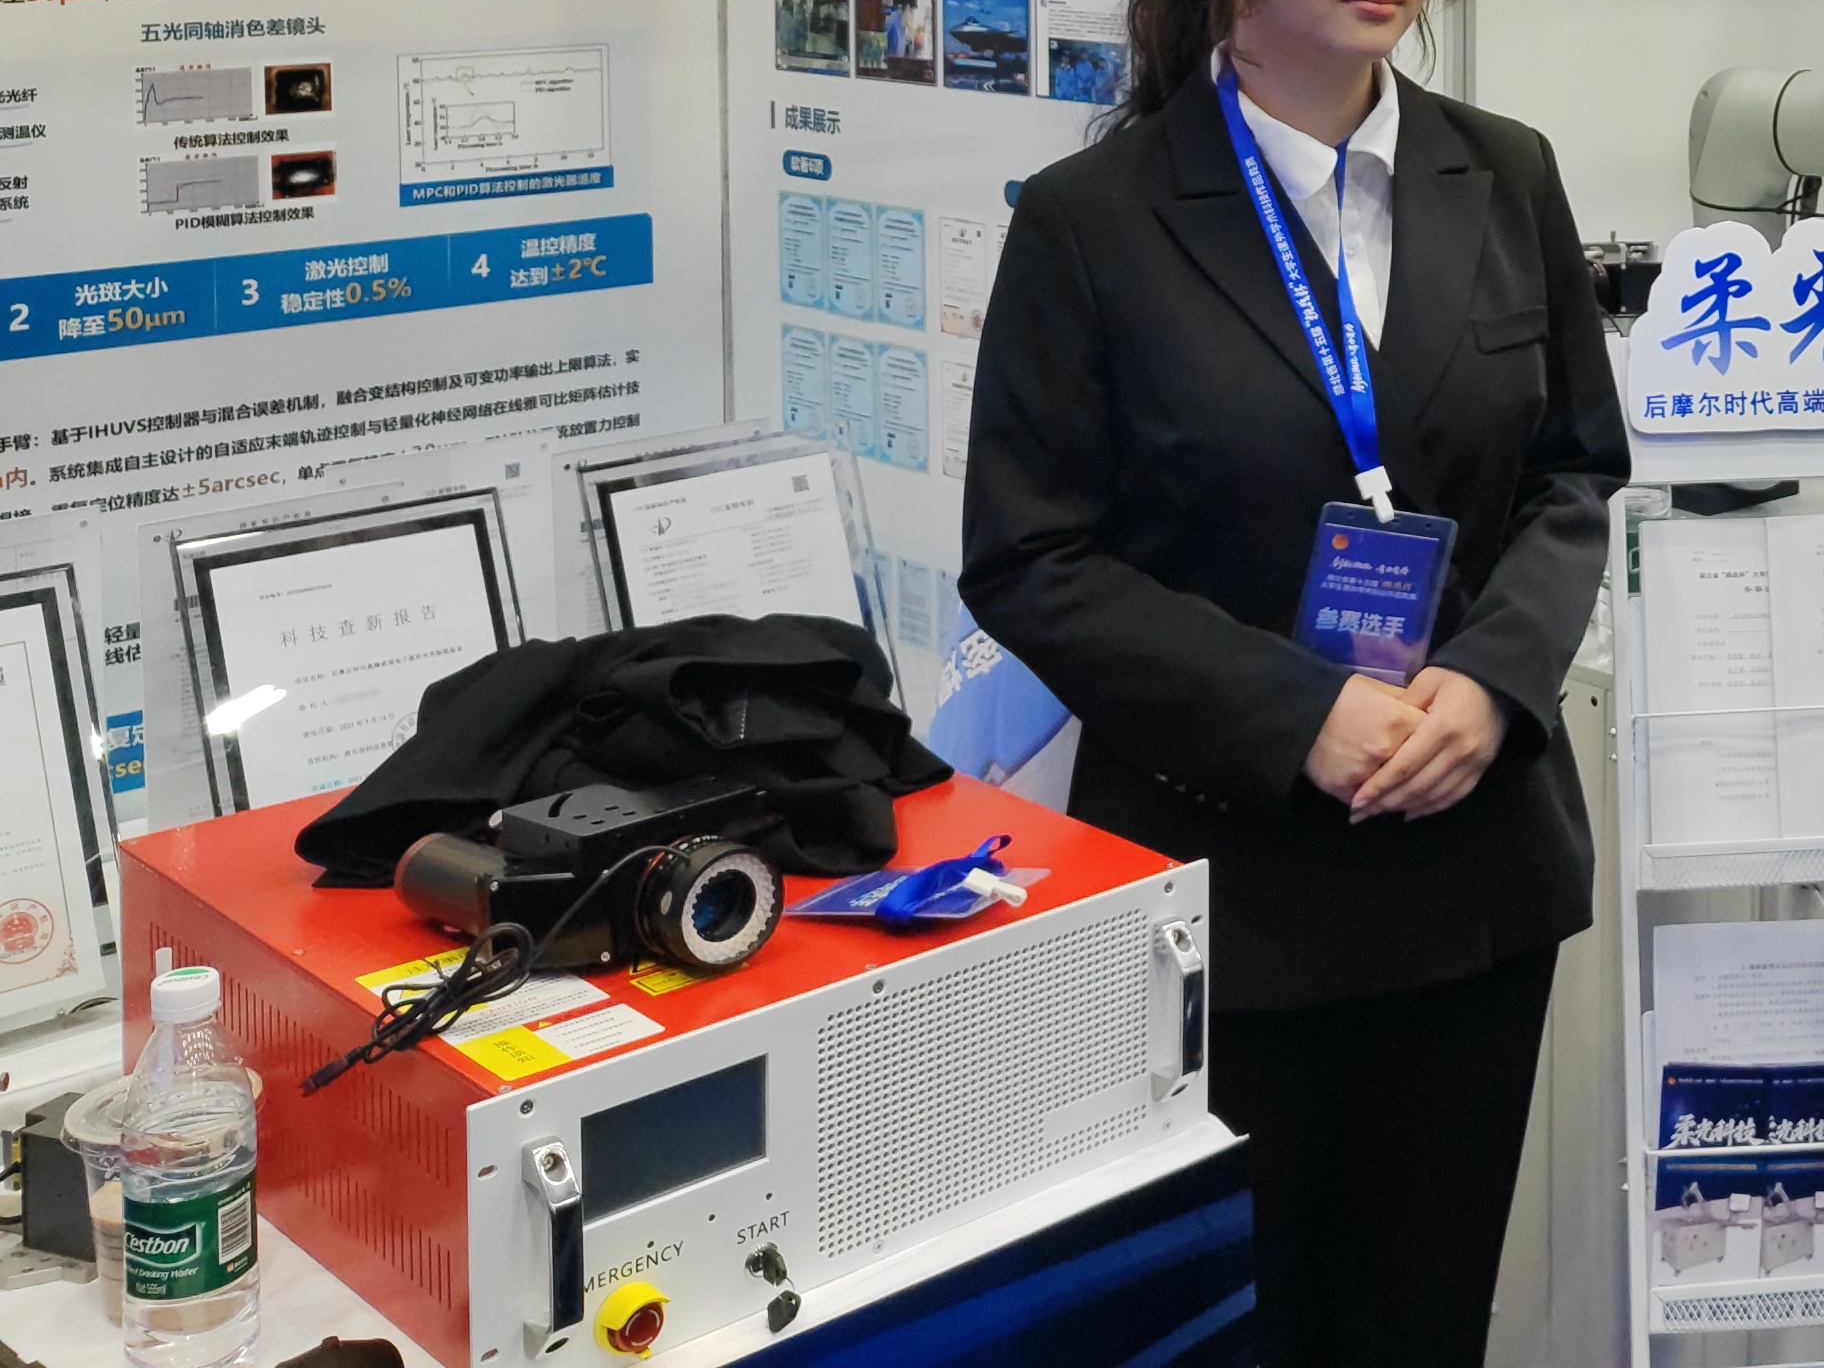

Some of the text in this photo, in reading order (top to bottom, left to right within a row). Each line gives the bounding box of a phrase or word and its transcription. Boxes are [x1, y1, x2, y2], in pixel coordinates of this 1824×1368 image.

[140, 16, 326, 43] 五光同轴消色差镜头
[0, 88, 38, 103] 光纤
[785, 104, 841, 134] 成果展示
[173, 128, 290, 151] 传统算法控制效果
[520, 232, 597, 260] 温控精度
[304, 252, 390, 282] 激光控制
[470, 253, 491, 279] 4
[75, 276, 169, 308] 光斑大小
[241, 278, 260, 306] 3
[280, 276, 412, 316] 稳定性0.5%
[9, 303, 30, 333] 2
[280, 604, 437, 648] 科技查新报告
[736, 1210, 791, 1246] START
